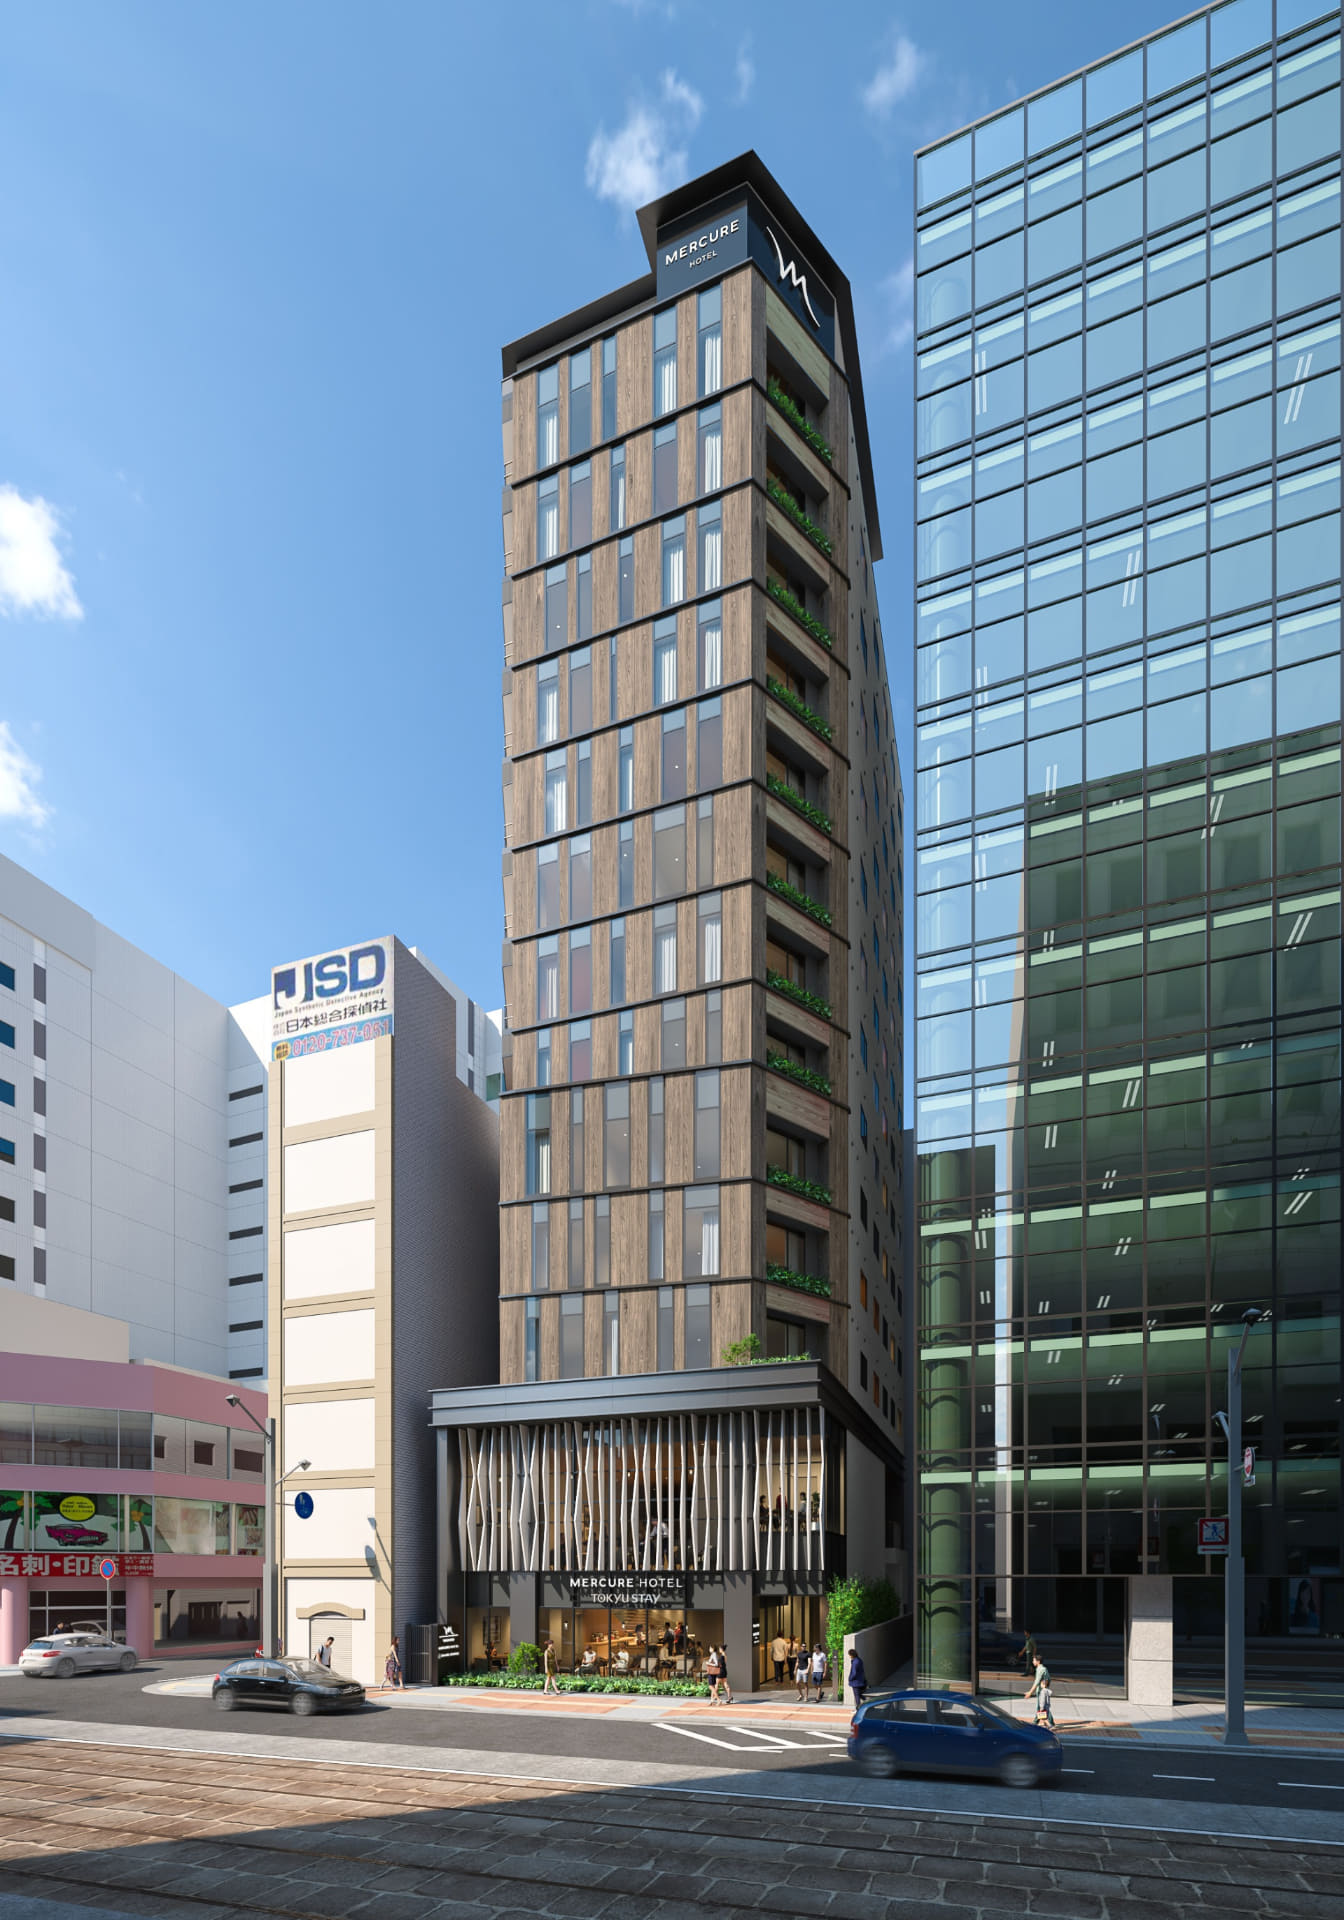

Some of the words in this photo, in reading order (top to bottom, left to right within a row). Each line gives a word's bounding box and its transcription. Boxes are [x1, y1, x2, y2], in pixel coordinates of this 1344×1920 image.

[665, 219, 740, 266] MERCURE
[689, 249, 718, 269] HOTEL
[359, 988, 384, 999] Agency
[292, 1019, 390, 1057] 0120-737-051
[569, 1578, 634, 1588] MERCURE
[639, 1578, 683, 1588] HOTEL
[590, 1593, 629, 1604] TOKYU
[631, 1594, 660, 1604] STAY
